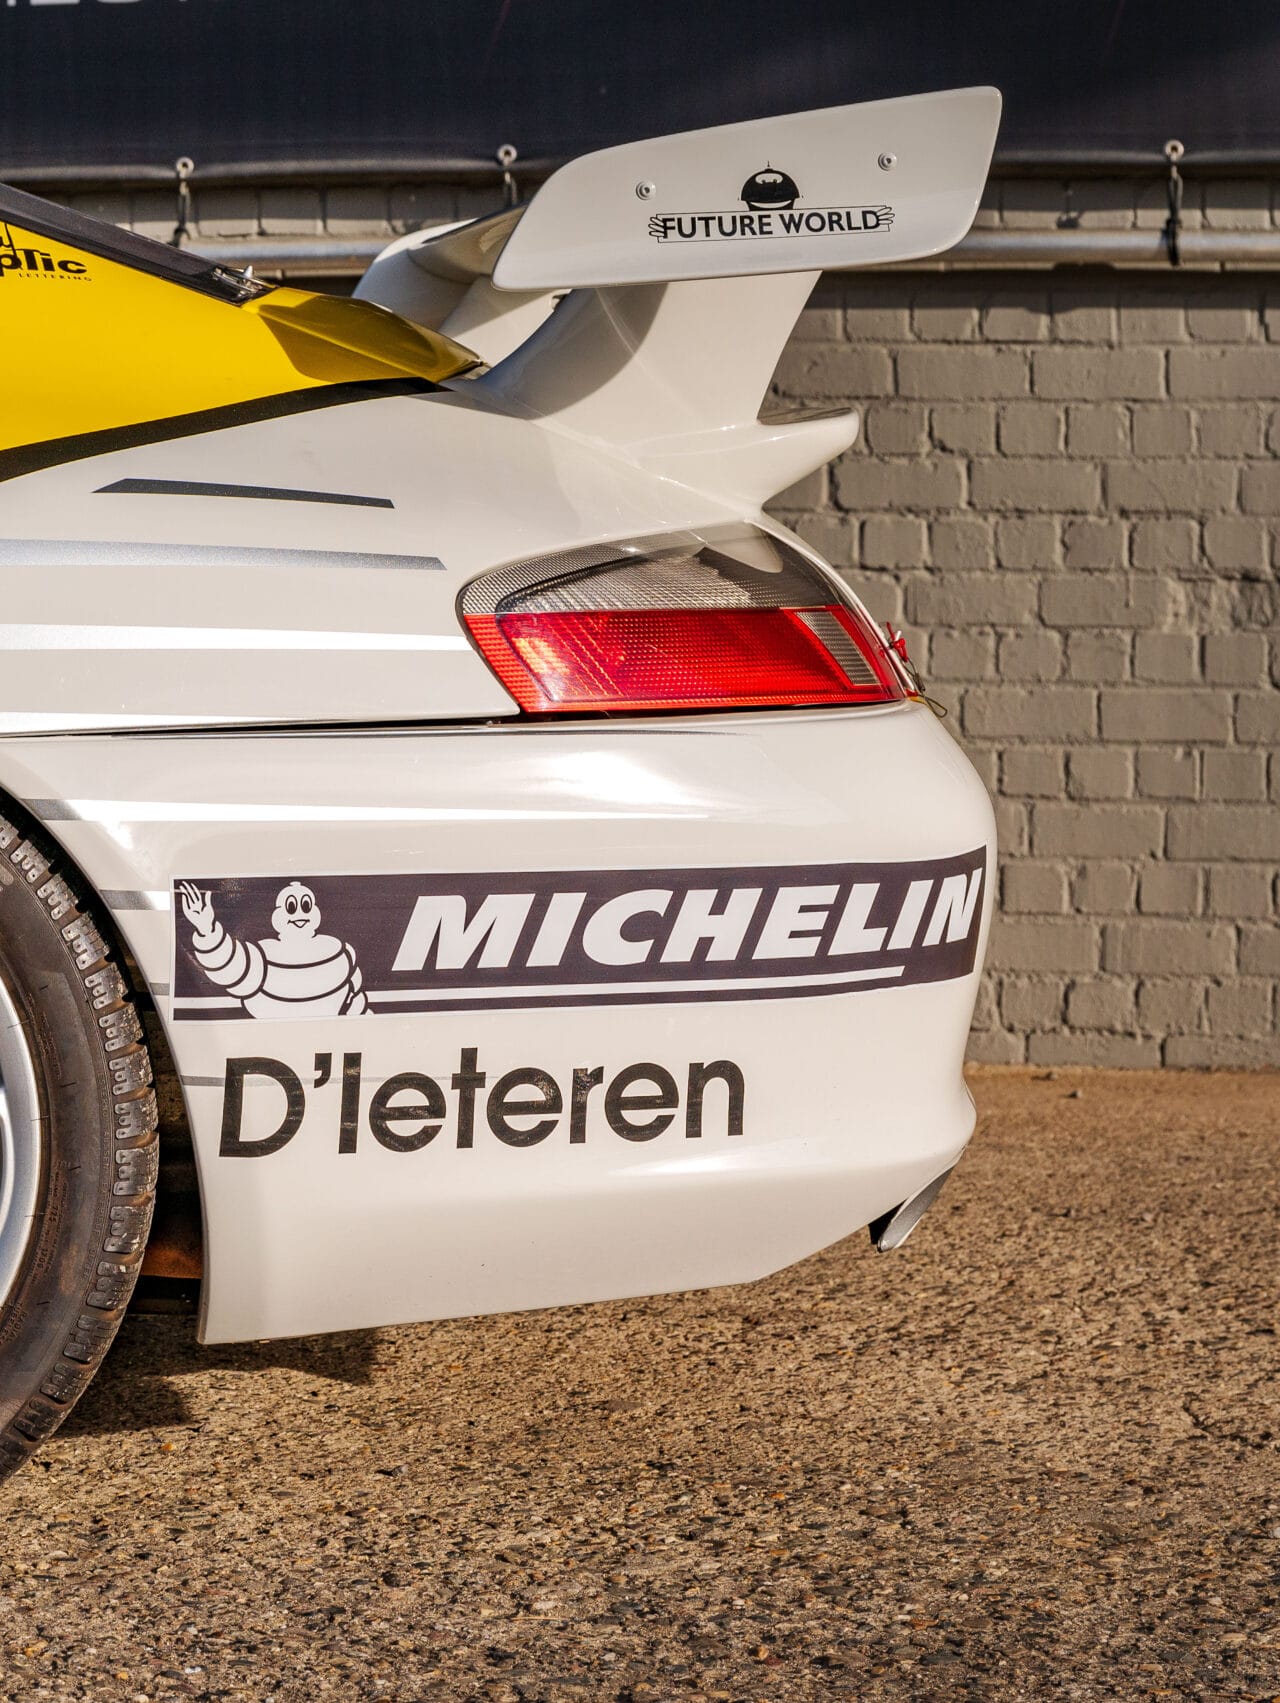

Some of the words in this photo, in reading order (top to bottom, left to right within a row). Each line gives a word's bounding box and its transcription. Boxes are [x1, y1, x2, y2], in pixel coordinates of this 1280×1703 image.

[662, 214, 772, 239] FUTURE
[779, 210, 881, 235] WORLD
[391, 866, 983, 972] MICHELIN
[218, 1047, 746, 1158] D'Ieteren
